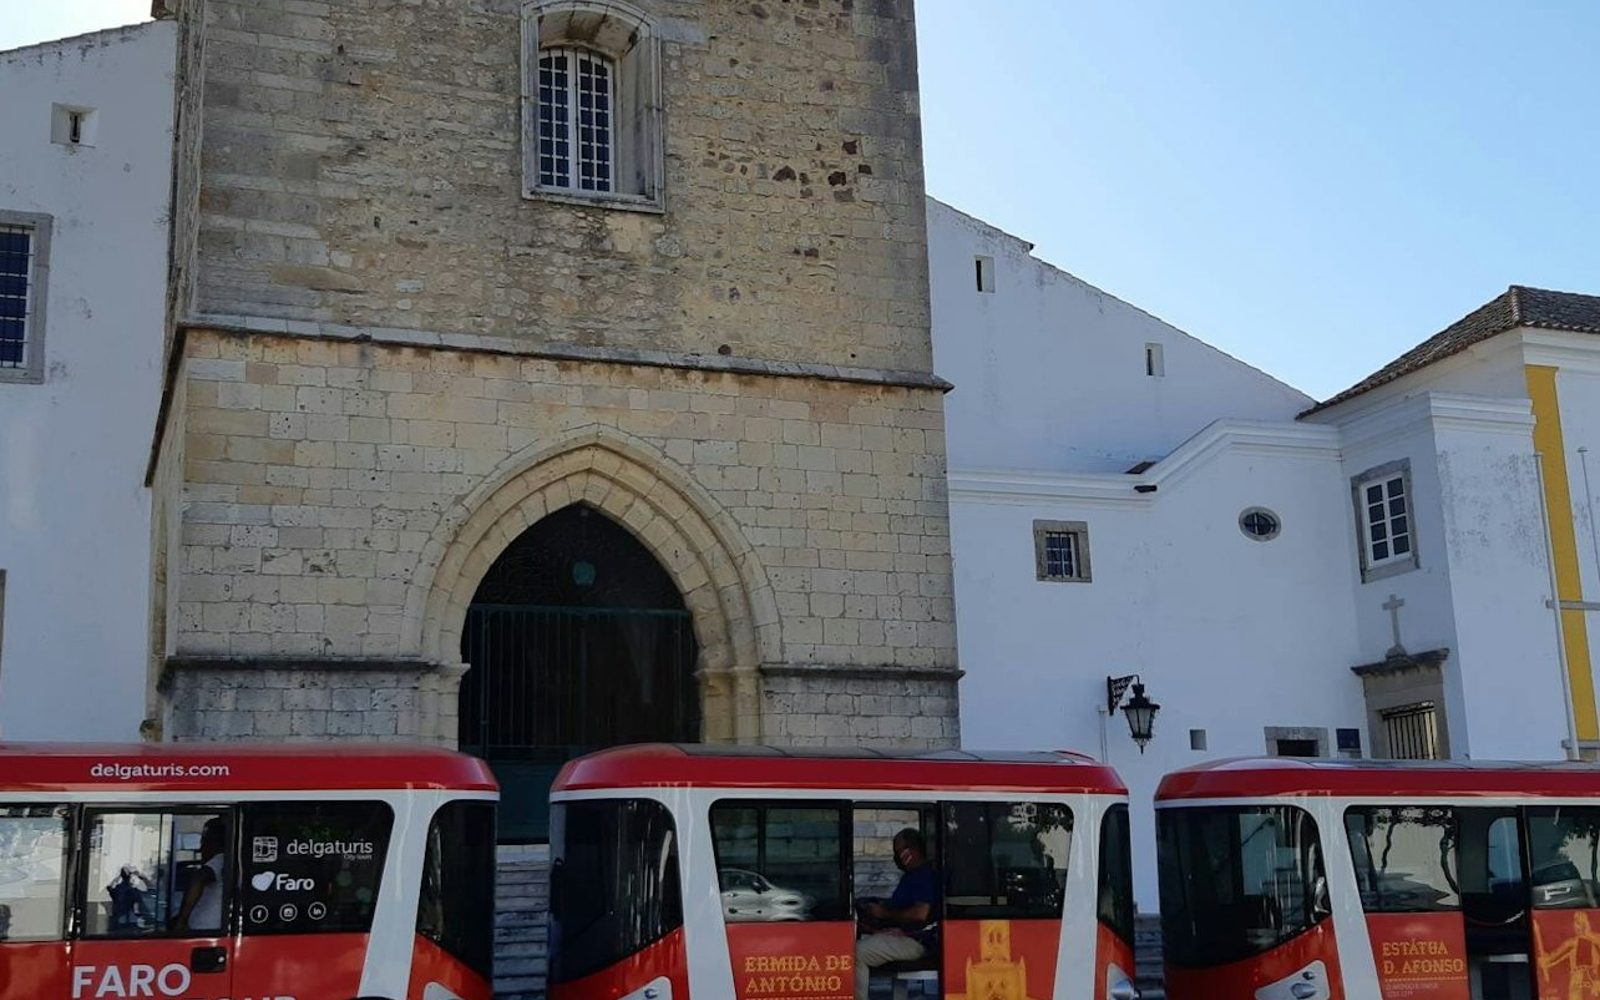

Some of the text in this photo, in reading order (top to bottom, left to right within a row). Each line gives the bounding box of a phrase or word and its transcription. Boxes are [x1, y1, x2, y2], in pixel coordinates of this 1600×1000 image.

[90, 763, 230, 780] delgaturis.com
[286, 839, 373, 859] delgaturis
[276, 873, 315, 891] Faro
[1382, 937, 1448, 957] ESTÁTUA
[745, 955, 852, 972] ERMIDA DE
[1402, 958, 1464, 974] AFONSO
[72, 963, 191, 999] FARO
[745, 973, 842, 993] ANTÓNIO
